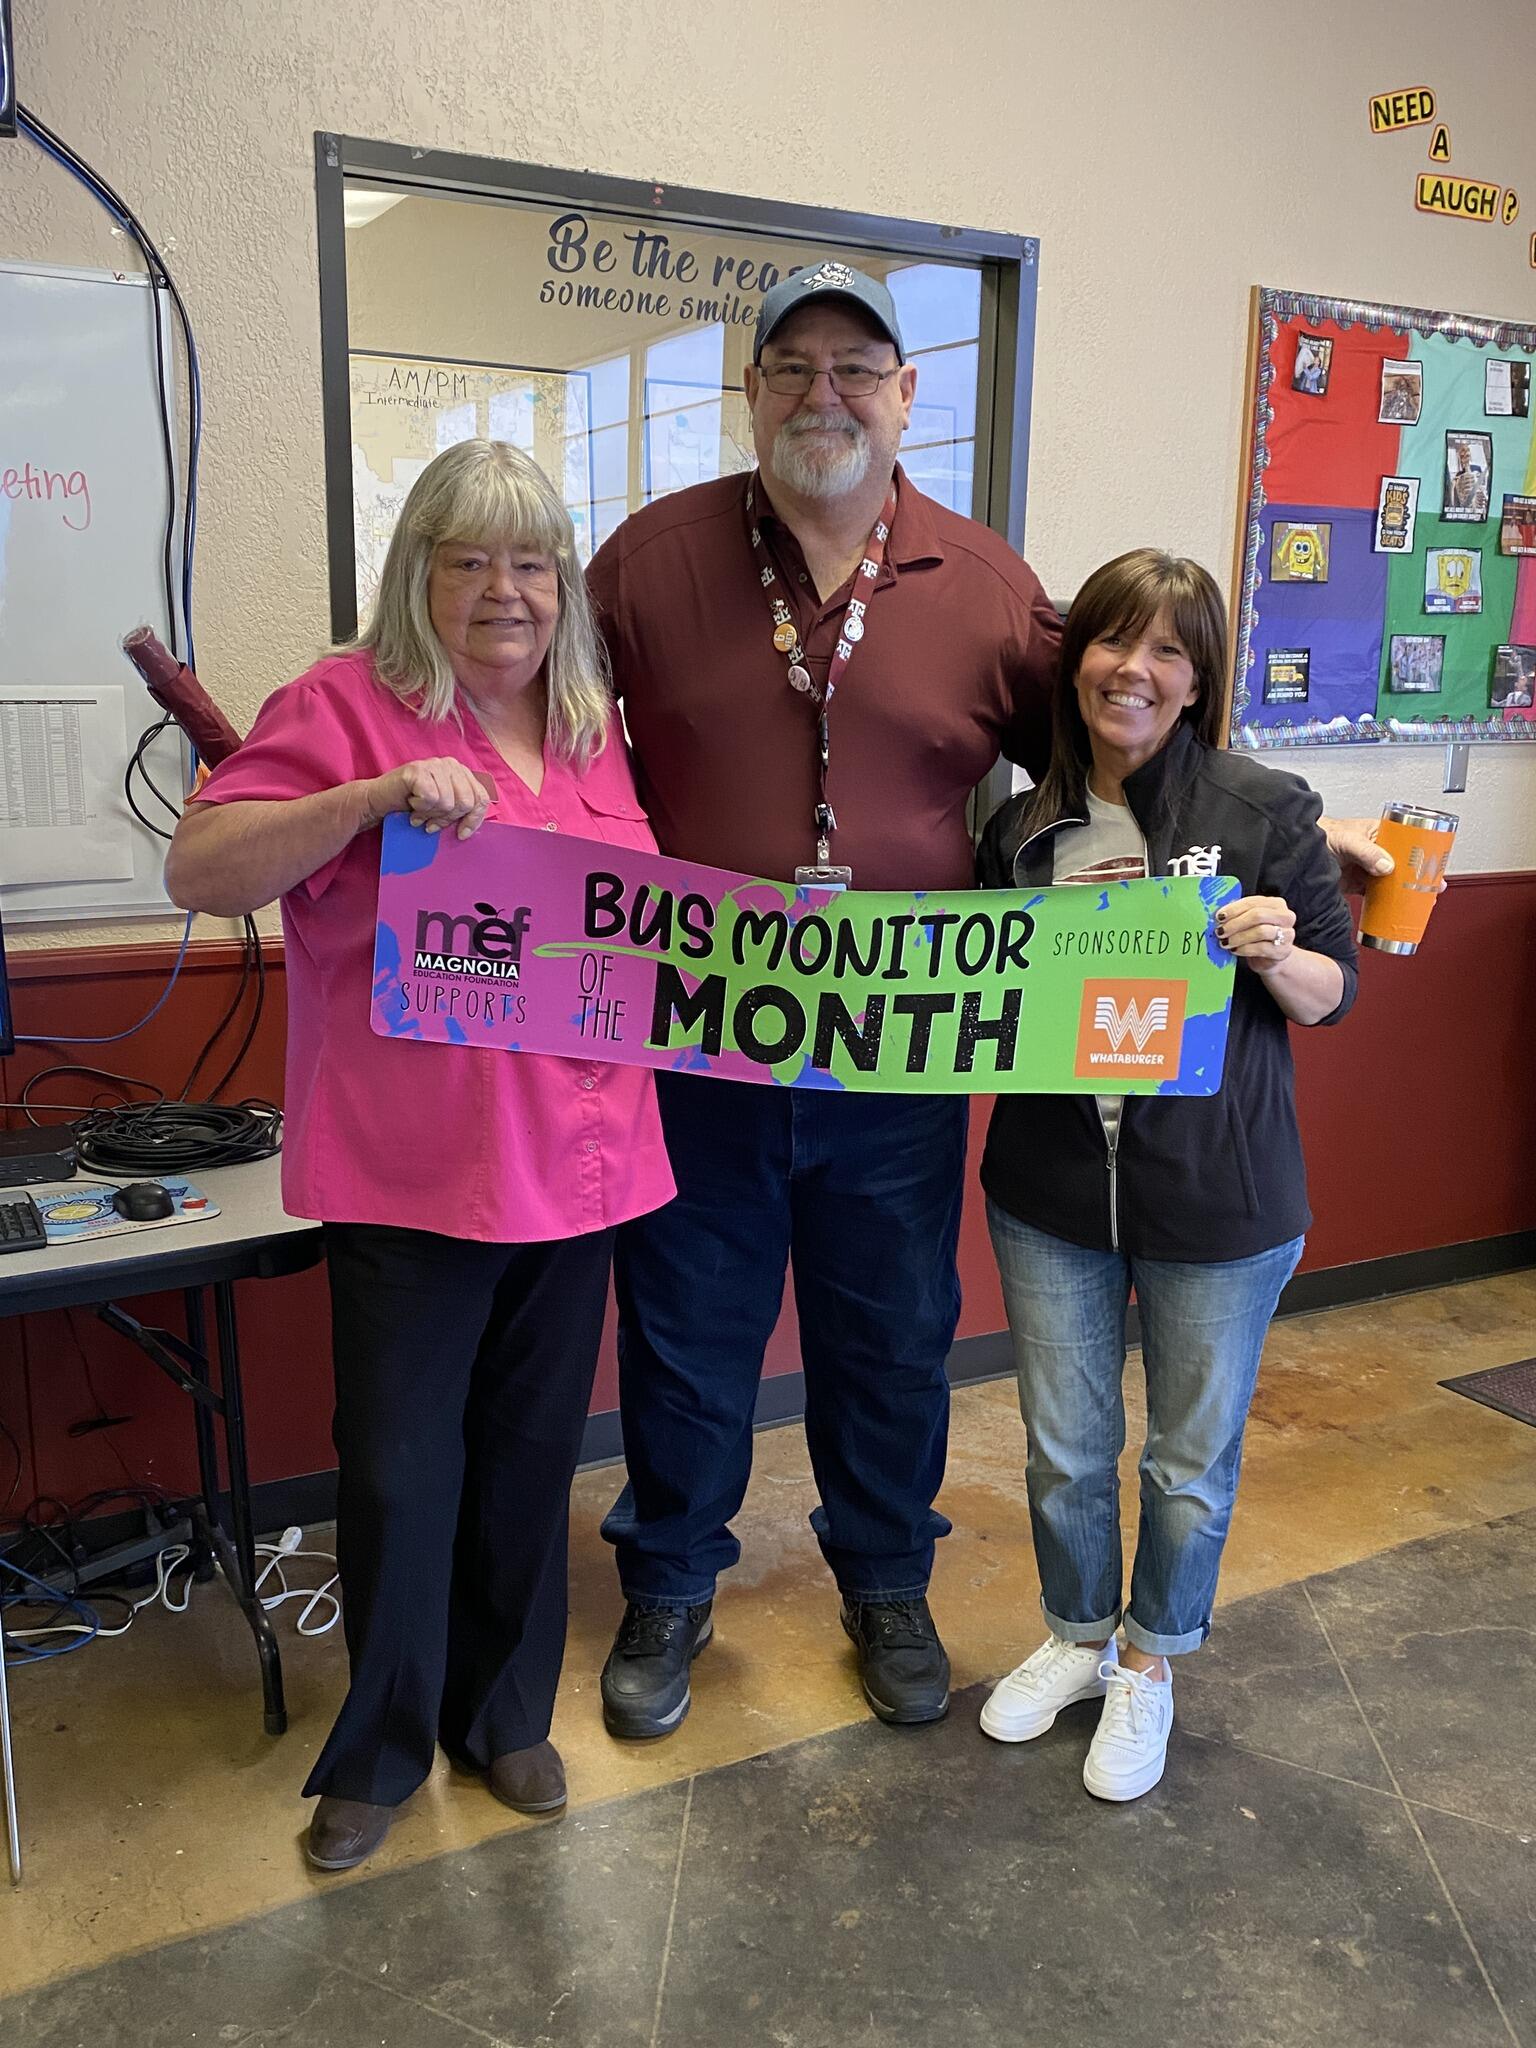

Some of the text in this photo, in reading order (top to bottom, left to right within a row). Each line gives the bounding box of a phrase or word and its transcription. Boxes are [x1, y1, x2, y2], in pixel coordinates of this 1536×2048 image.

[1373, 90, 1434, 129] NEED
[1432, 129, 1450, 157] A
[1420, 178, 1497, 217] LAUGH
[547, 213, 617, 273] Be
[623, 229, 699, 283] the
[539, 280, 763, 327] someone smile
[360, 391, 440, 409] Intermediate
[388, 367, 468, 399] AM/PM
[0, 462, 91, 531] eting
[1386, 491, 1408, 504] KIDS
[1381, 535, 1404, 547] SEATS
[416, 904, 532, 961] mef
[584, 872, 1036, 979] BUS MONITOR
[1052, 929, 1170, 956] SPONSORED
[413, 970, 519, 988] EDUCATION FOUNDATION
[415, 953, 519, 979] MAGNOLIA
[578, 953, 614, 996] OF
[400, 981, 526, 1024] SUPPORTS
[578, 996, 627, 1042] THE
[649, 962, 1024, 1073] MONTH
[1089, 1052, 1165, 1065] WHATABURGER
